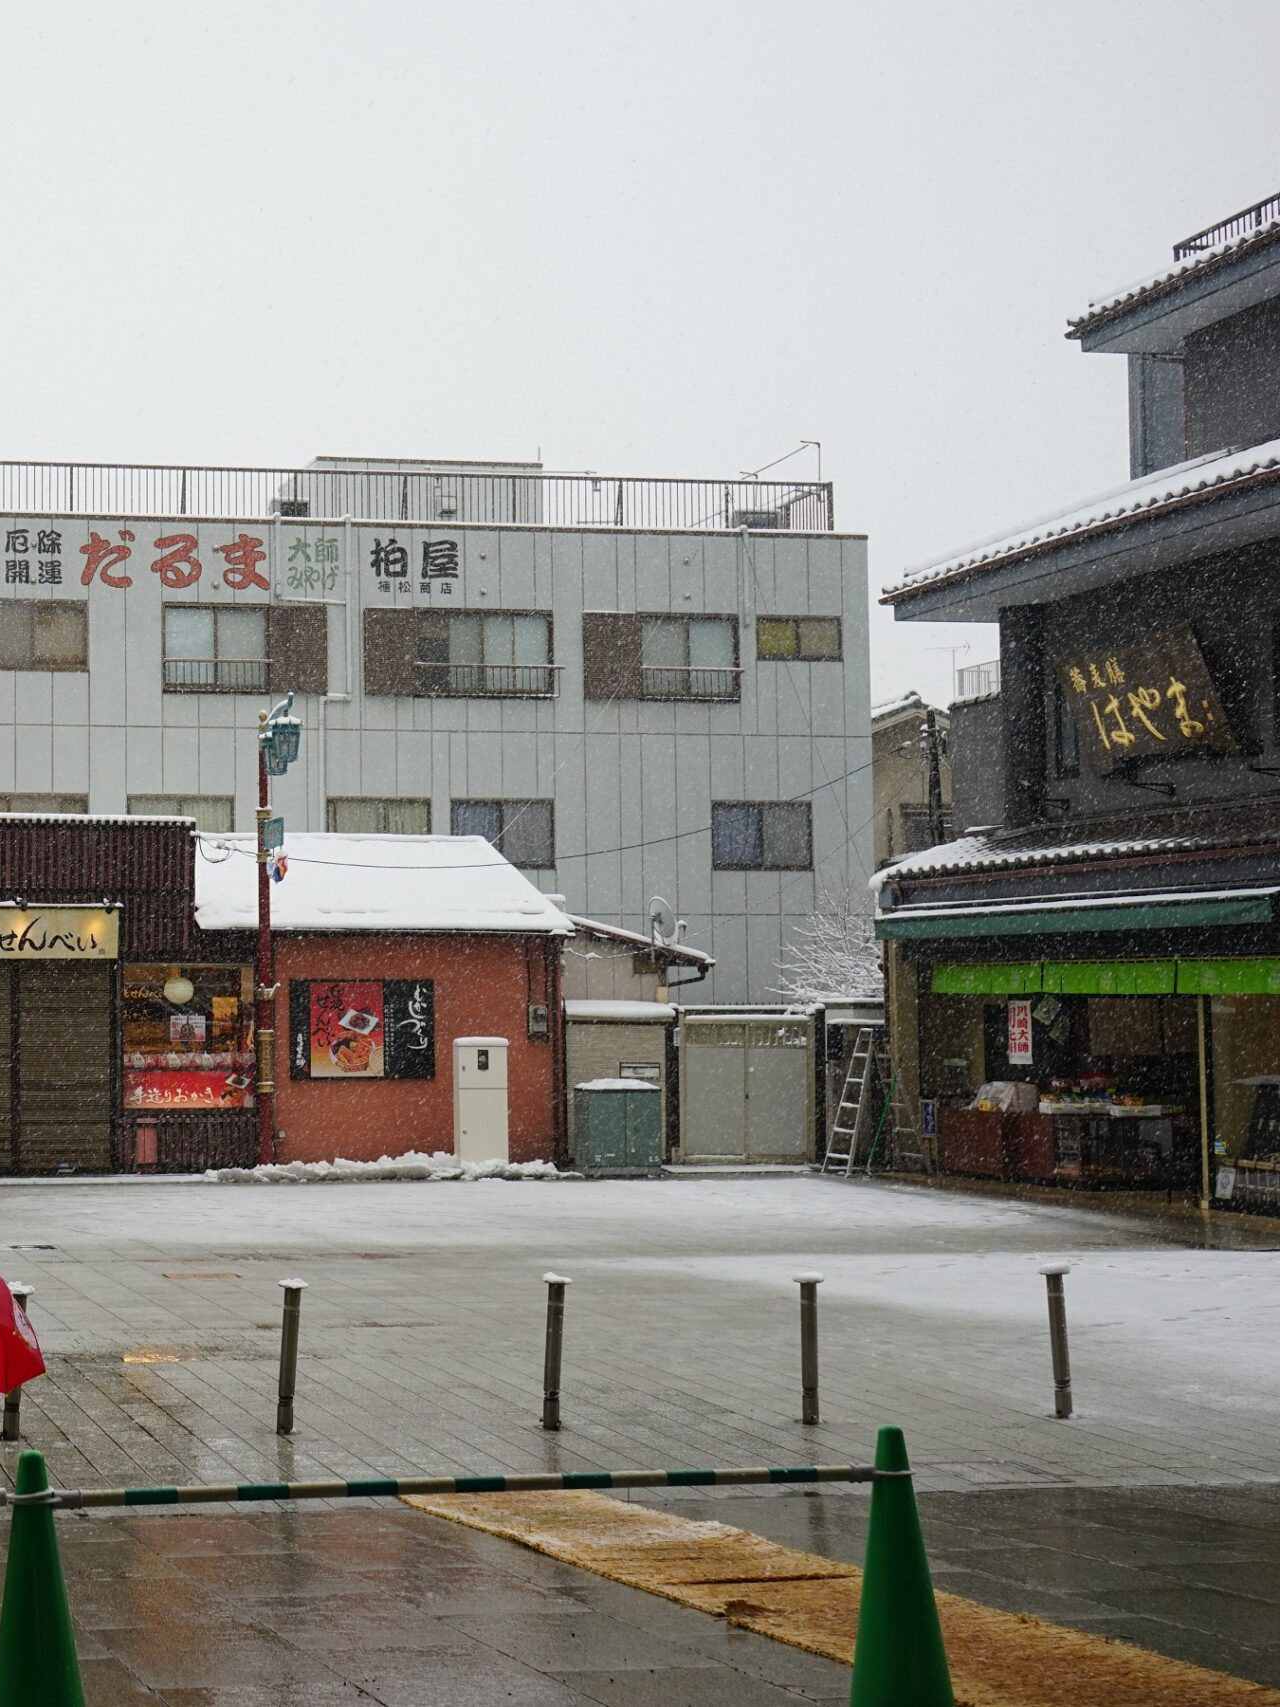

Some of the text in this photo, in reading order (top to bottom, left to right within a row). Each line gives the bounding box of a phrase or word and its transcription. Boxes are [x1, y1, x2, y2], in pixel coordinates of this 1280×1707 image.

[4, 528, 63, 555] 厄除
[287, 536, 339, 564] 大師
[78, 529, 271, 591] だるま
[370, 537, 459, 579] 柏屋
[4, 560, 63, 586] 開運
[286, 566, 339, 591] みやげ
[377, 580, 453, 596] 植松商店
[1090, 675, 1206, 750] はやま
[1015, 1004, 1030, 1054] 川崎大師
[129, 1085, 215, 1105] 手造りおかき
